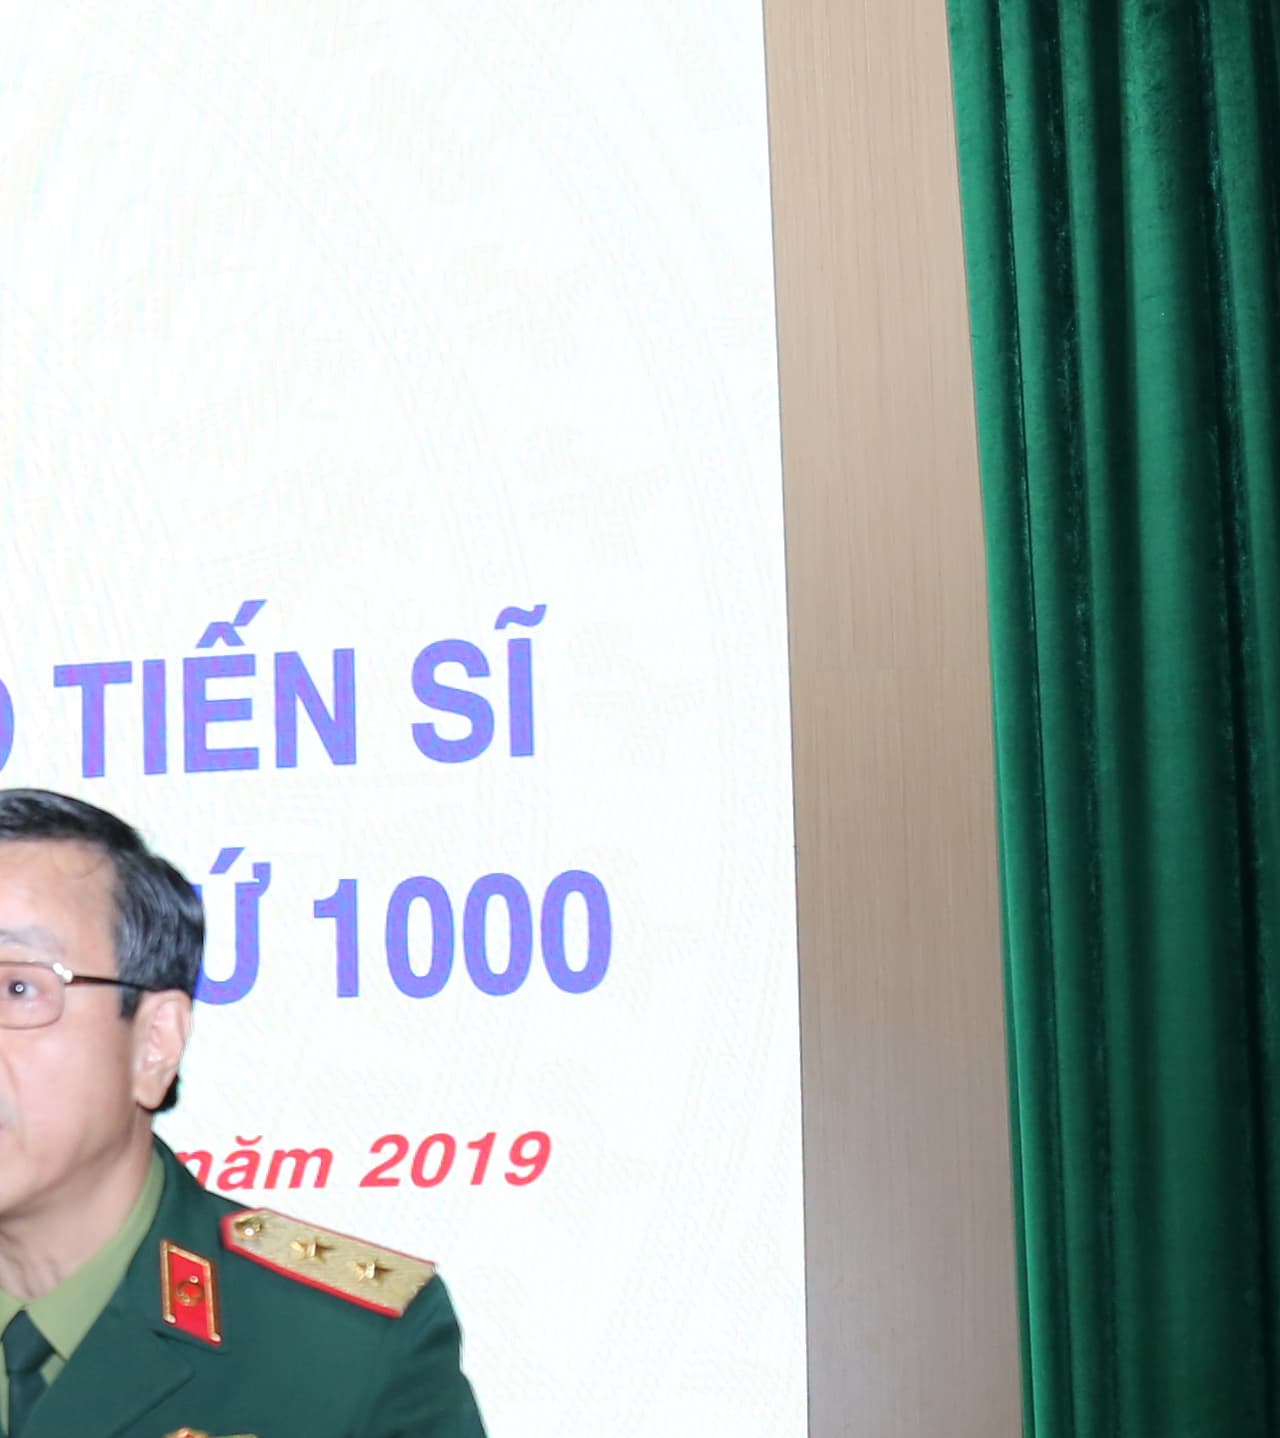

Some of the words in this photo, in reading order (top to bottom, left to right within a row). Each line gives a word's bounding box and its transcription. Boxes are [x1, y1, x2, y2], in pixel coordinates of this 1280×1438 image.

[54, 600, 356, 778] TIẾN
[413, 605, 546, 763] SĨ
[314, 870, 611, 998] 1000
[194, 1136, 333, 1190] năm
[360, 1131, 551, 1188] 2019
